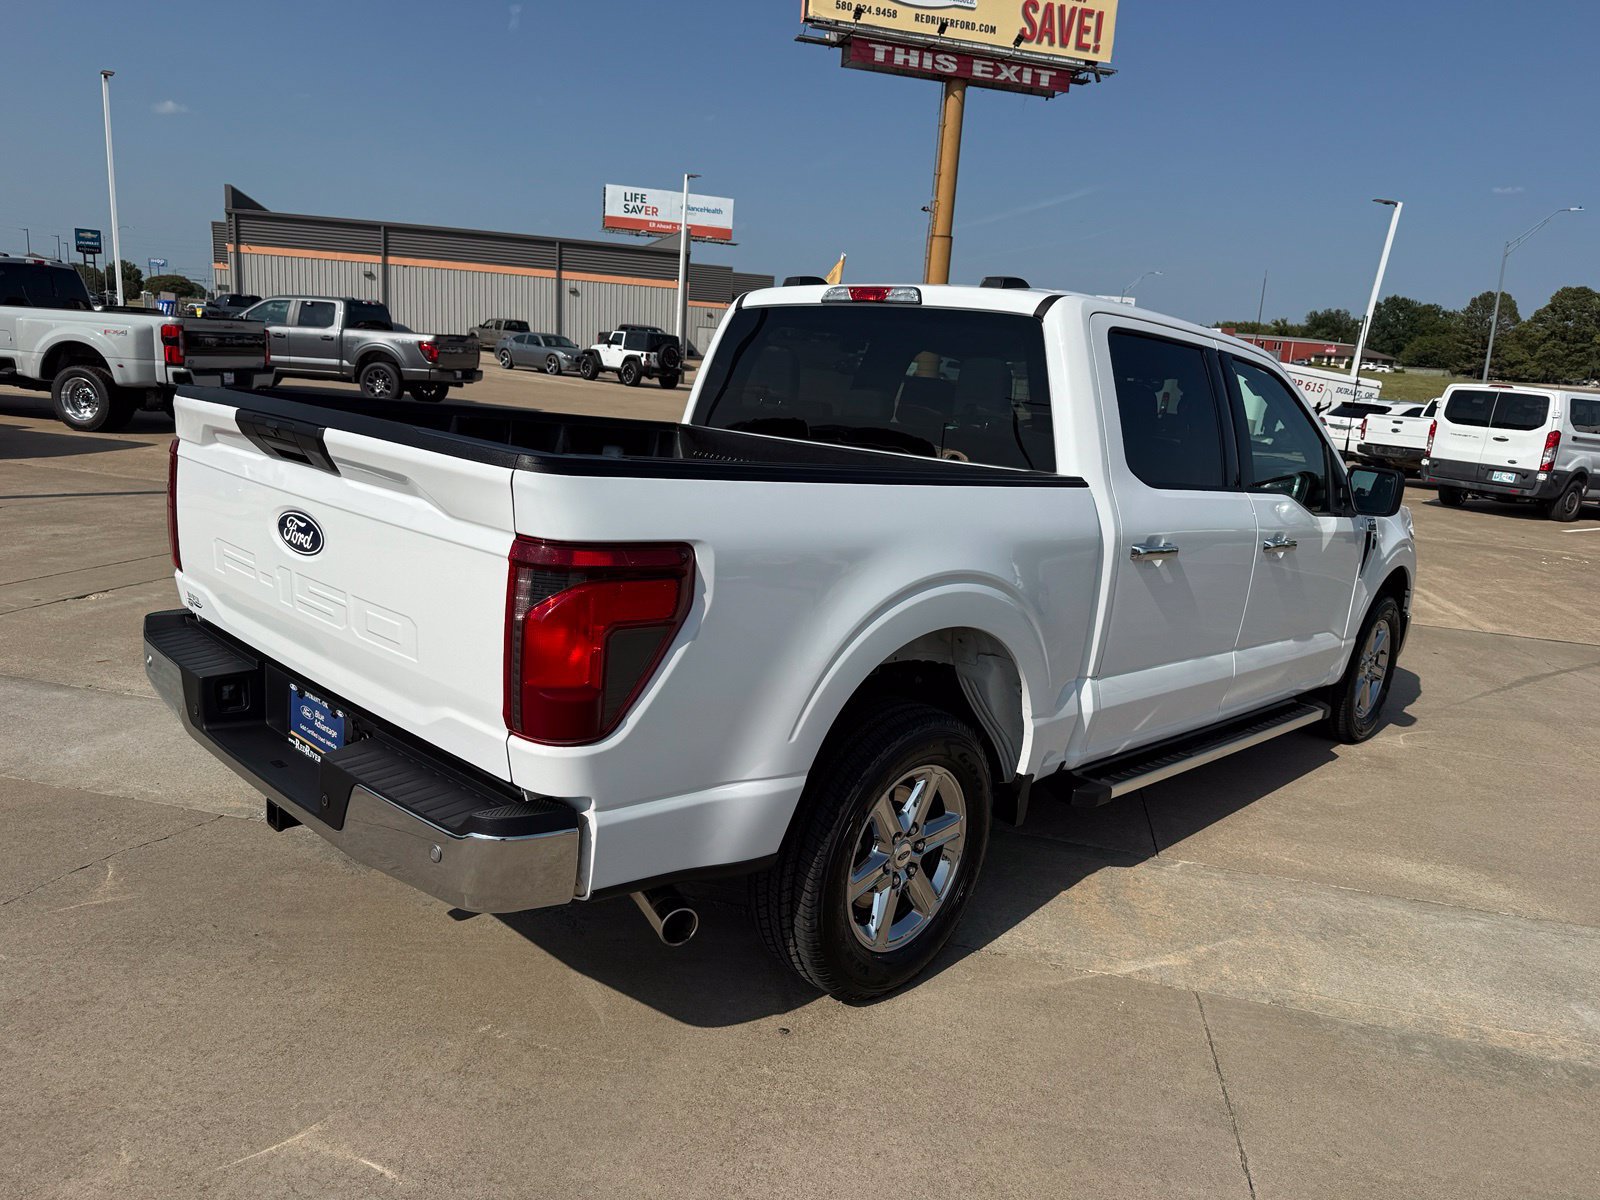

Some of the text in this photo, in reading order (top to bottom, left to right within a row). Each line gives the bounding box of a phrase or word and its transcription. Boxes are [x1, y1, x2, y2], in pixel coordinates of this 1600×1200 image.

[914, 13, 997, 35] REDRIVERFORD.COM
[1020, 0, 1105, 53] SAVE!
[868, 43, 1057, 87] THIS EXIT
[624, 192, 647, 203] LIFE
[624, 204, 659, 217] SAVER
[1304, 381, 1324, 393] 615
[283, 515, 314, 550] Ford
[214, 537, 418, 663] F-150
